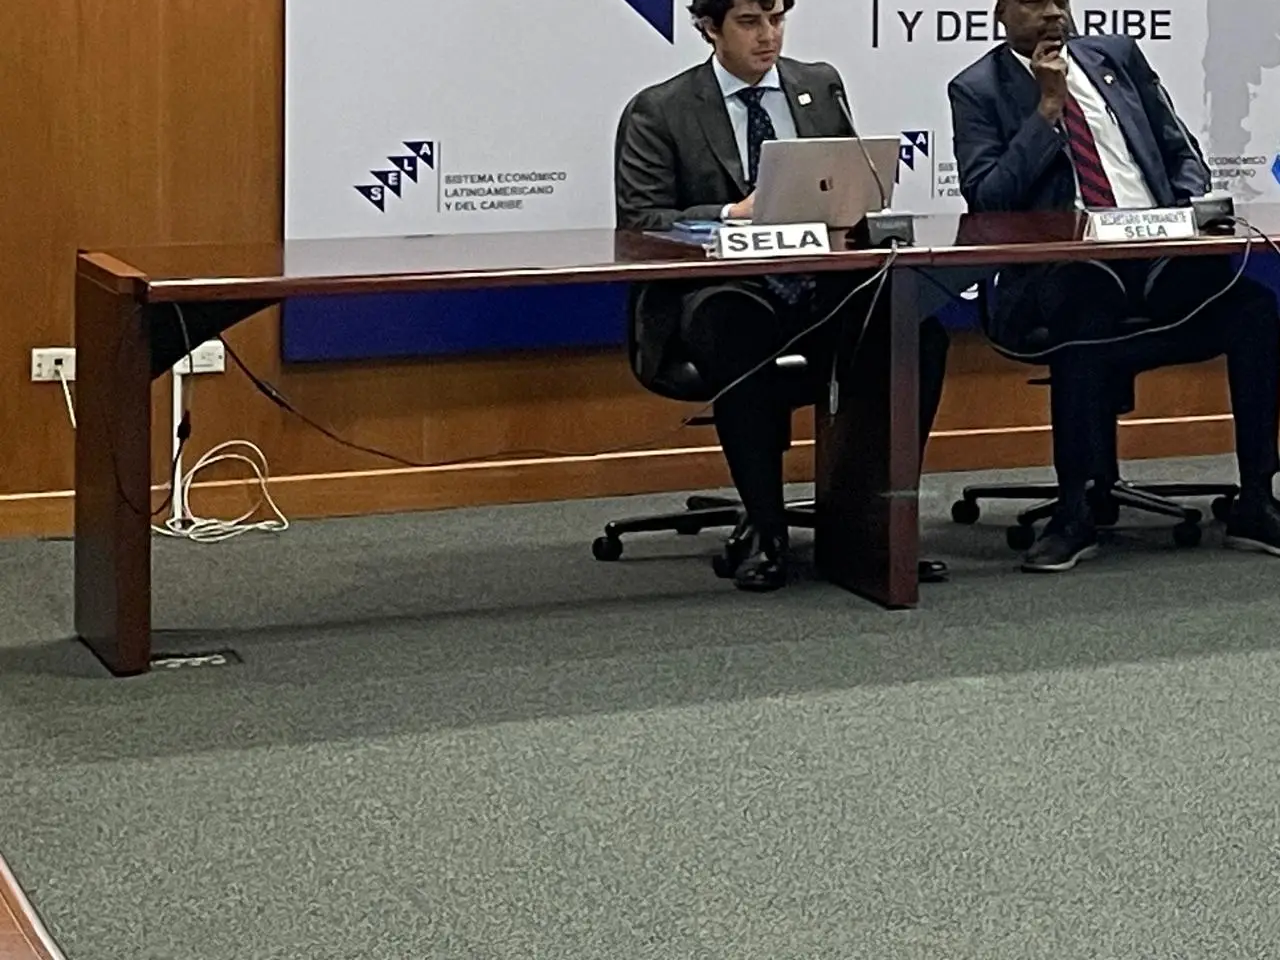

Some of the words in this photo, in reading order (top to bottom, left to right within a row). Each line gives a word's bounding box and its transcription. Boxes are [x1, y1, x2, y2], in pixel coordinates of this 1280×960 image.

[898, 10, 923, 41] Y
[727, 230, 823, 252] SELA
[1124, 225, 1168, 238] SELA
